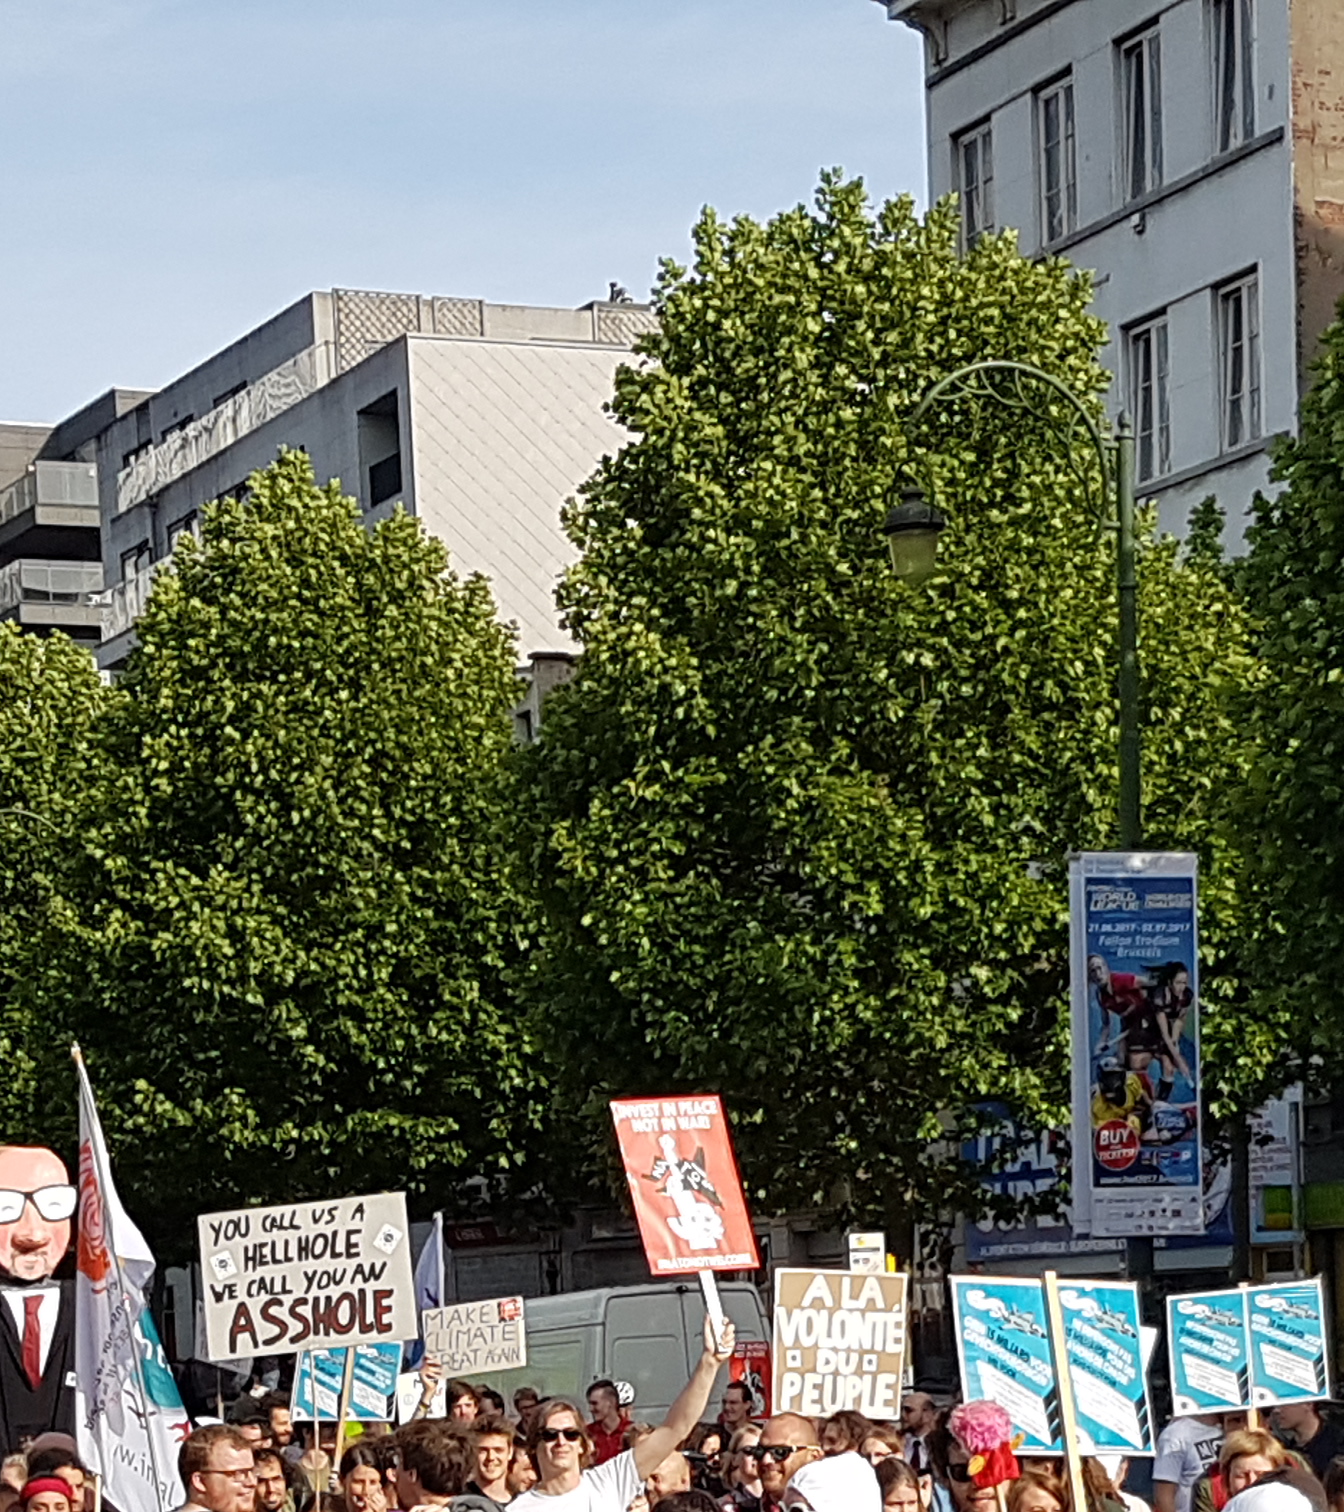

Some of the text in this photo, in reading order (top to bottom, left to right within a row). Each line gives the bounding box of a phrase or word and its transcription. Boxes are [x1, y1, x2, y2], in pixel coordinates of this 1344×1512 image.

[616, 1100, 718, 1119] INVEST IN PEACE
[631, 1117, 659, 1132] NOT
[661, 1116, 678, 1131] IN
[1100, 1129, 1129, 1145] BUY
[210, 1202, 365, 1247] YOU CALL US A
[244, 1229, 362, 1273] HELLHOLE
[210, 1261, 387, 1303] WE CALL YOU AN
[801, 1274, 885, 1309] A LA
[229, 1288, 394, 1354] ASSHOLE
[425, 1304, 491, 1333] MAKE
[775, 1303, 903, 1354] VOLONTÉ
[426, 1324, 516, 1354] CLIMATE
[816, 1348, 859, 1375] DU
[781, 1372, 897, 1416] PEUPLE
